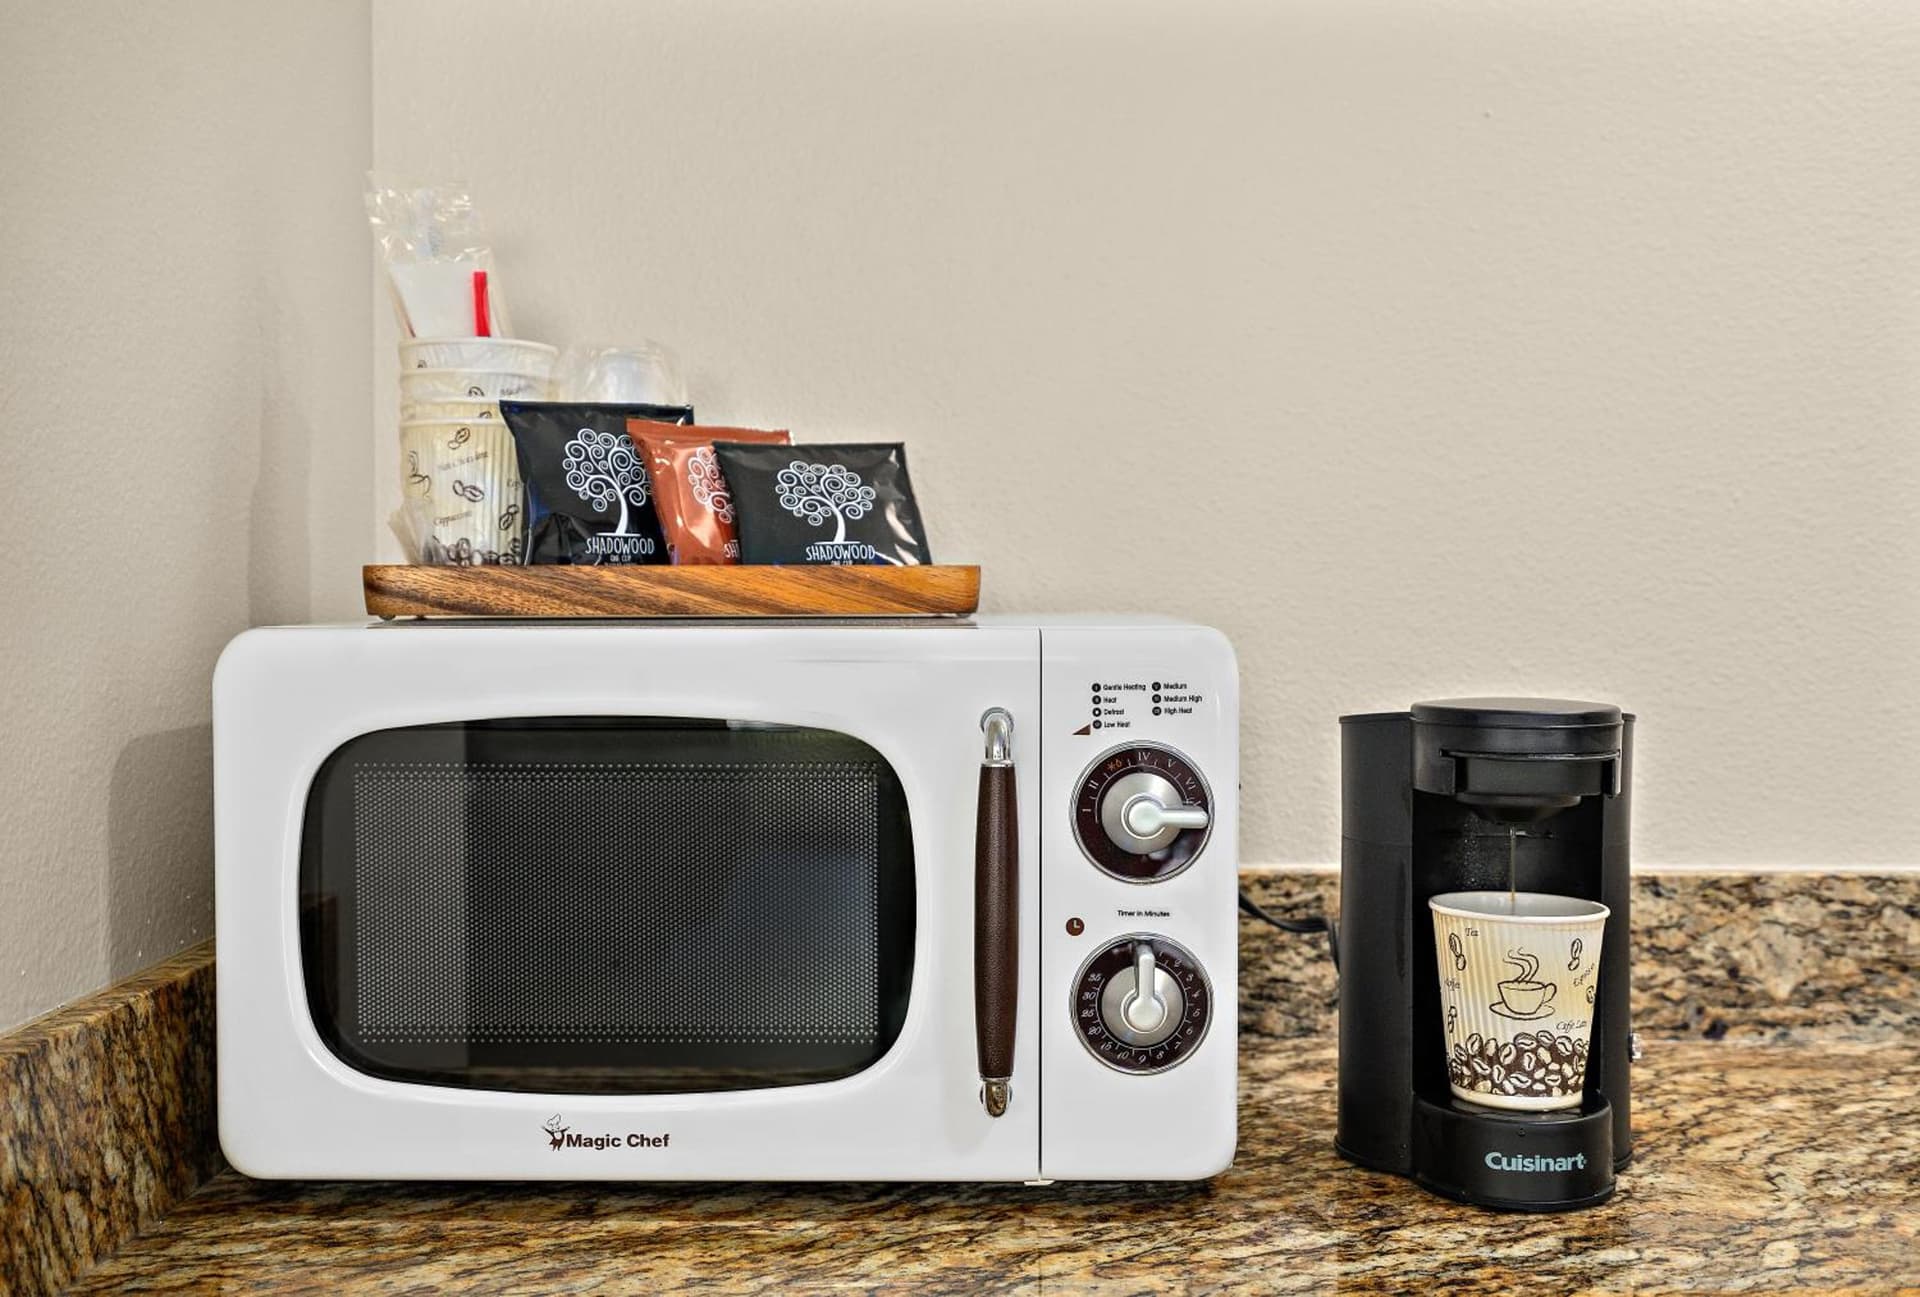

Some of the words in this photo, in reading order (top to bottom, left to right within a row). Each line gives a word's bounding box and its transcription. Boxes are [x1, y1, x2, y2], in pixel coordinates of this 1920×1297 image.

[585, 537, 655, 554] SHADOWOOD
[806, 544, 876, 561] SHADOWOOD
[1103, 683, 1122, 691] Gentle
[1123, 683, 1146, 692] Heating
[1163, 682, 1187, 690] Medium
[1189, 695, 1203, 703] High
[1103, 708, 1125, 716] Defrost
[1164, 707, 1178, 716] High
[1138, 751, 1151, 761] IV
[1117, 909, 1135, 917] Timer
[1144, 909, 1170, 918] Minutes
[1465, 927, 1479, 937] Tea
[1082, 992, 1096, 1001] 30
[1081, 1009, 1095, 1018] 25
[1088, 1027, 1101, 1036] 20
[1117, 1050, 1130, 1060] 10
[566, 1133, 621, 1150] Magic
[626, 1133, 670, 1148] Chef
[1484, 1151, 1585, 1172] Cuisinart
